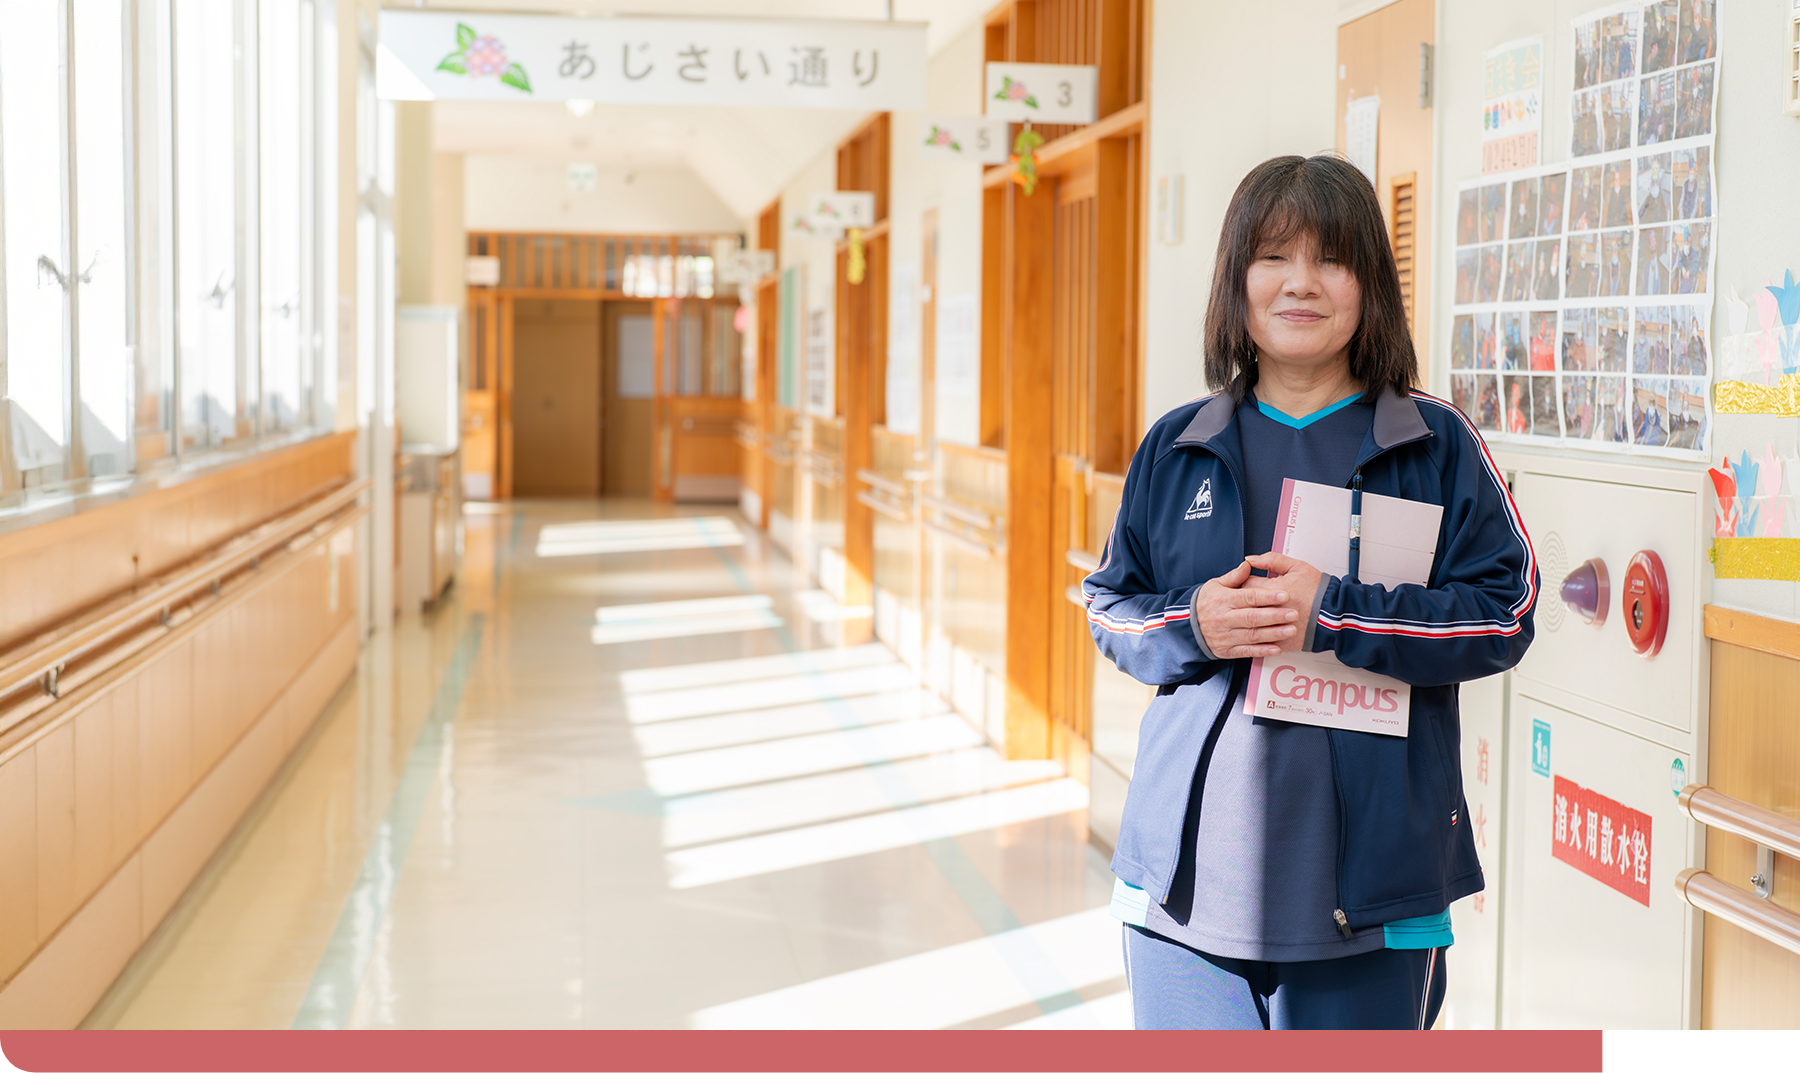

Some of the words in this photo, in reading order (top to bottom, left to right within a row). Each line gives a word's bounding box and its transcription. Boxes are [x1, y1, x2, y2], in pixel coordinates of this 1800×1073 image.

[558, 40, 880, 87] あじさい通り
[1057, 81, 1073, 108] 3
[976, 127, 990, 152] 5
[1290, 496, 1302, 525] Campus
[1269, 665, 1399, 715] Campus
[1555, 793, 1648, 885] 消火用散水栓
